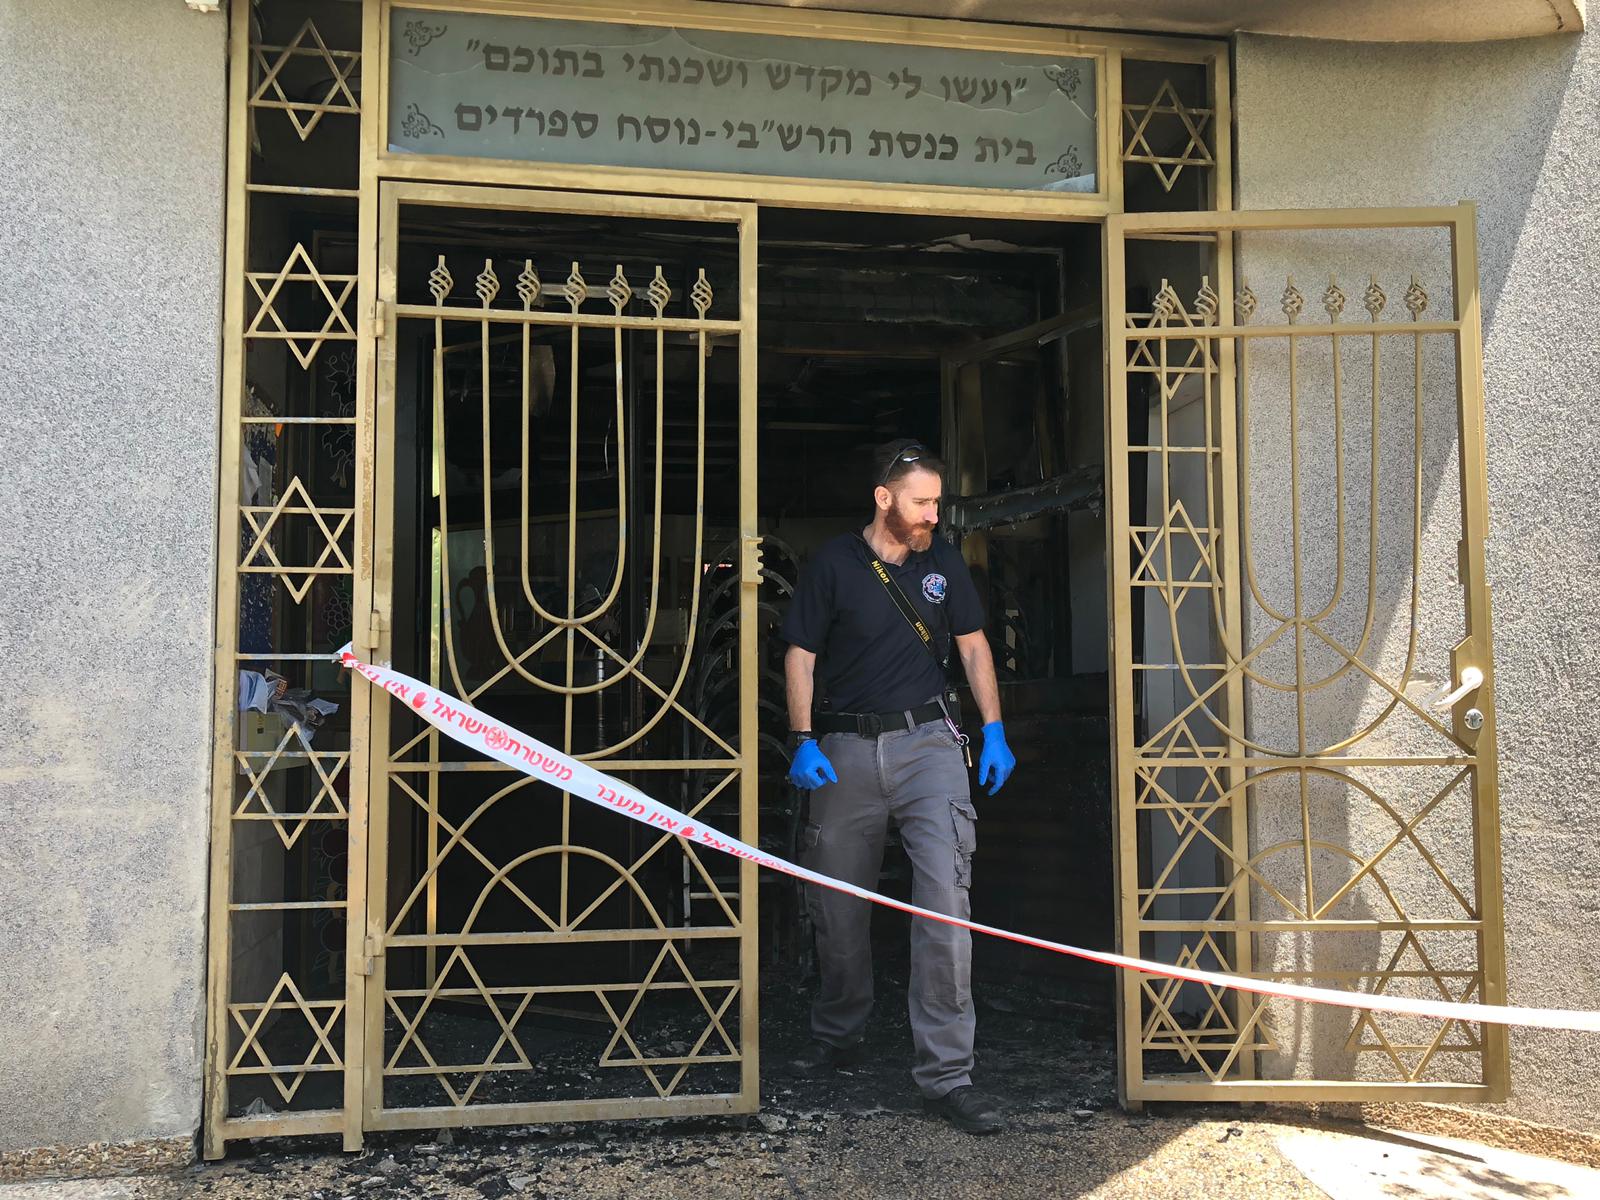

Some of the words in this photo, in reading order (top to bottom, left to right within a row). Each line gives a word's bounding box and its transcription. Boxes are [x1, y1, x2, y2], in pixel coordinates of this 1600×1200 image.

[622, 52, 748, 88] ושכנתי
[765, 62, 872, 101] מקדש
[887, 67, 922, 99] לי
[454, 102, 599, 139] ספרדים
[868, 129, 959, 160] כנסת
[974, 135, 1037, 165] בית
[871, 560, 890, 584] Nikon
[432, 697, 488, 735] ישראל
[504, 738, 573, 781] משטרת
[597, 783, 646, 816] מעבר
[647, 812, 679, 830] אין
